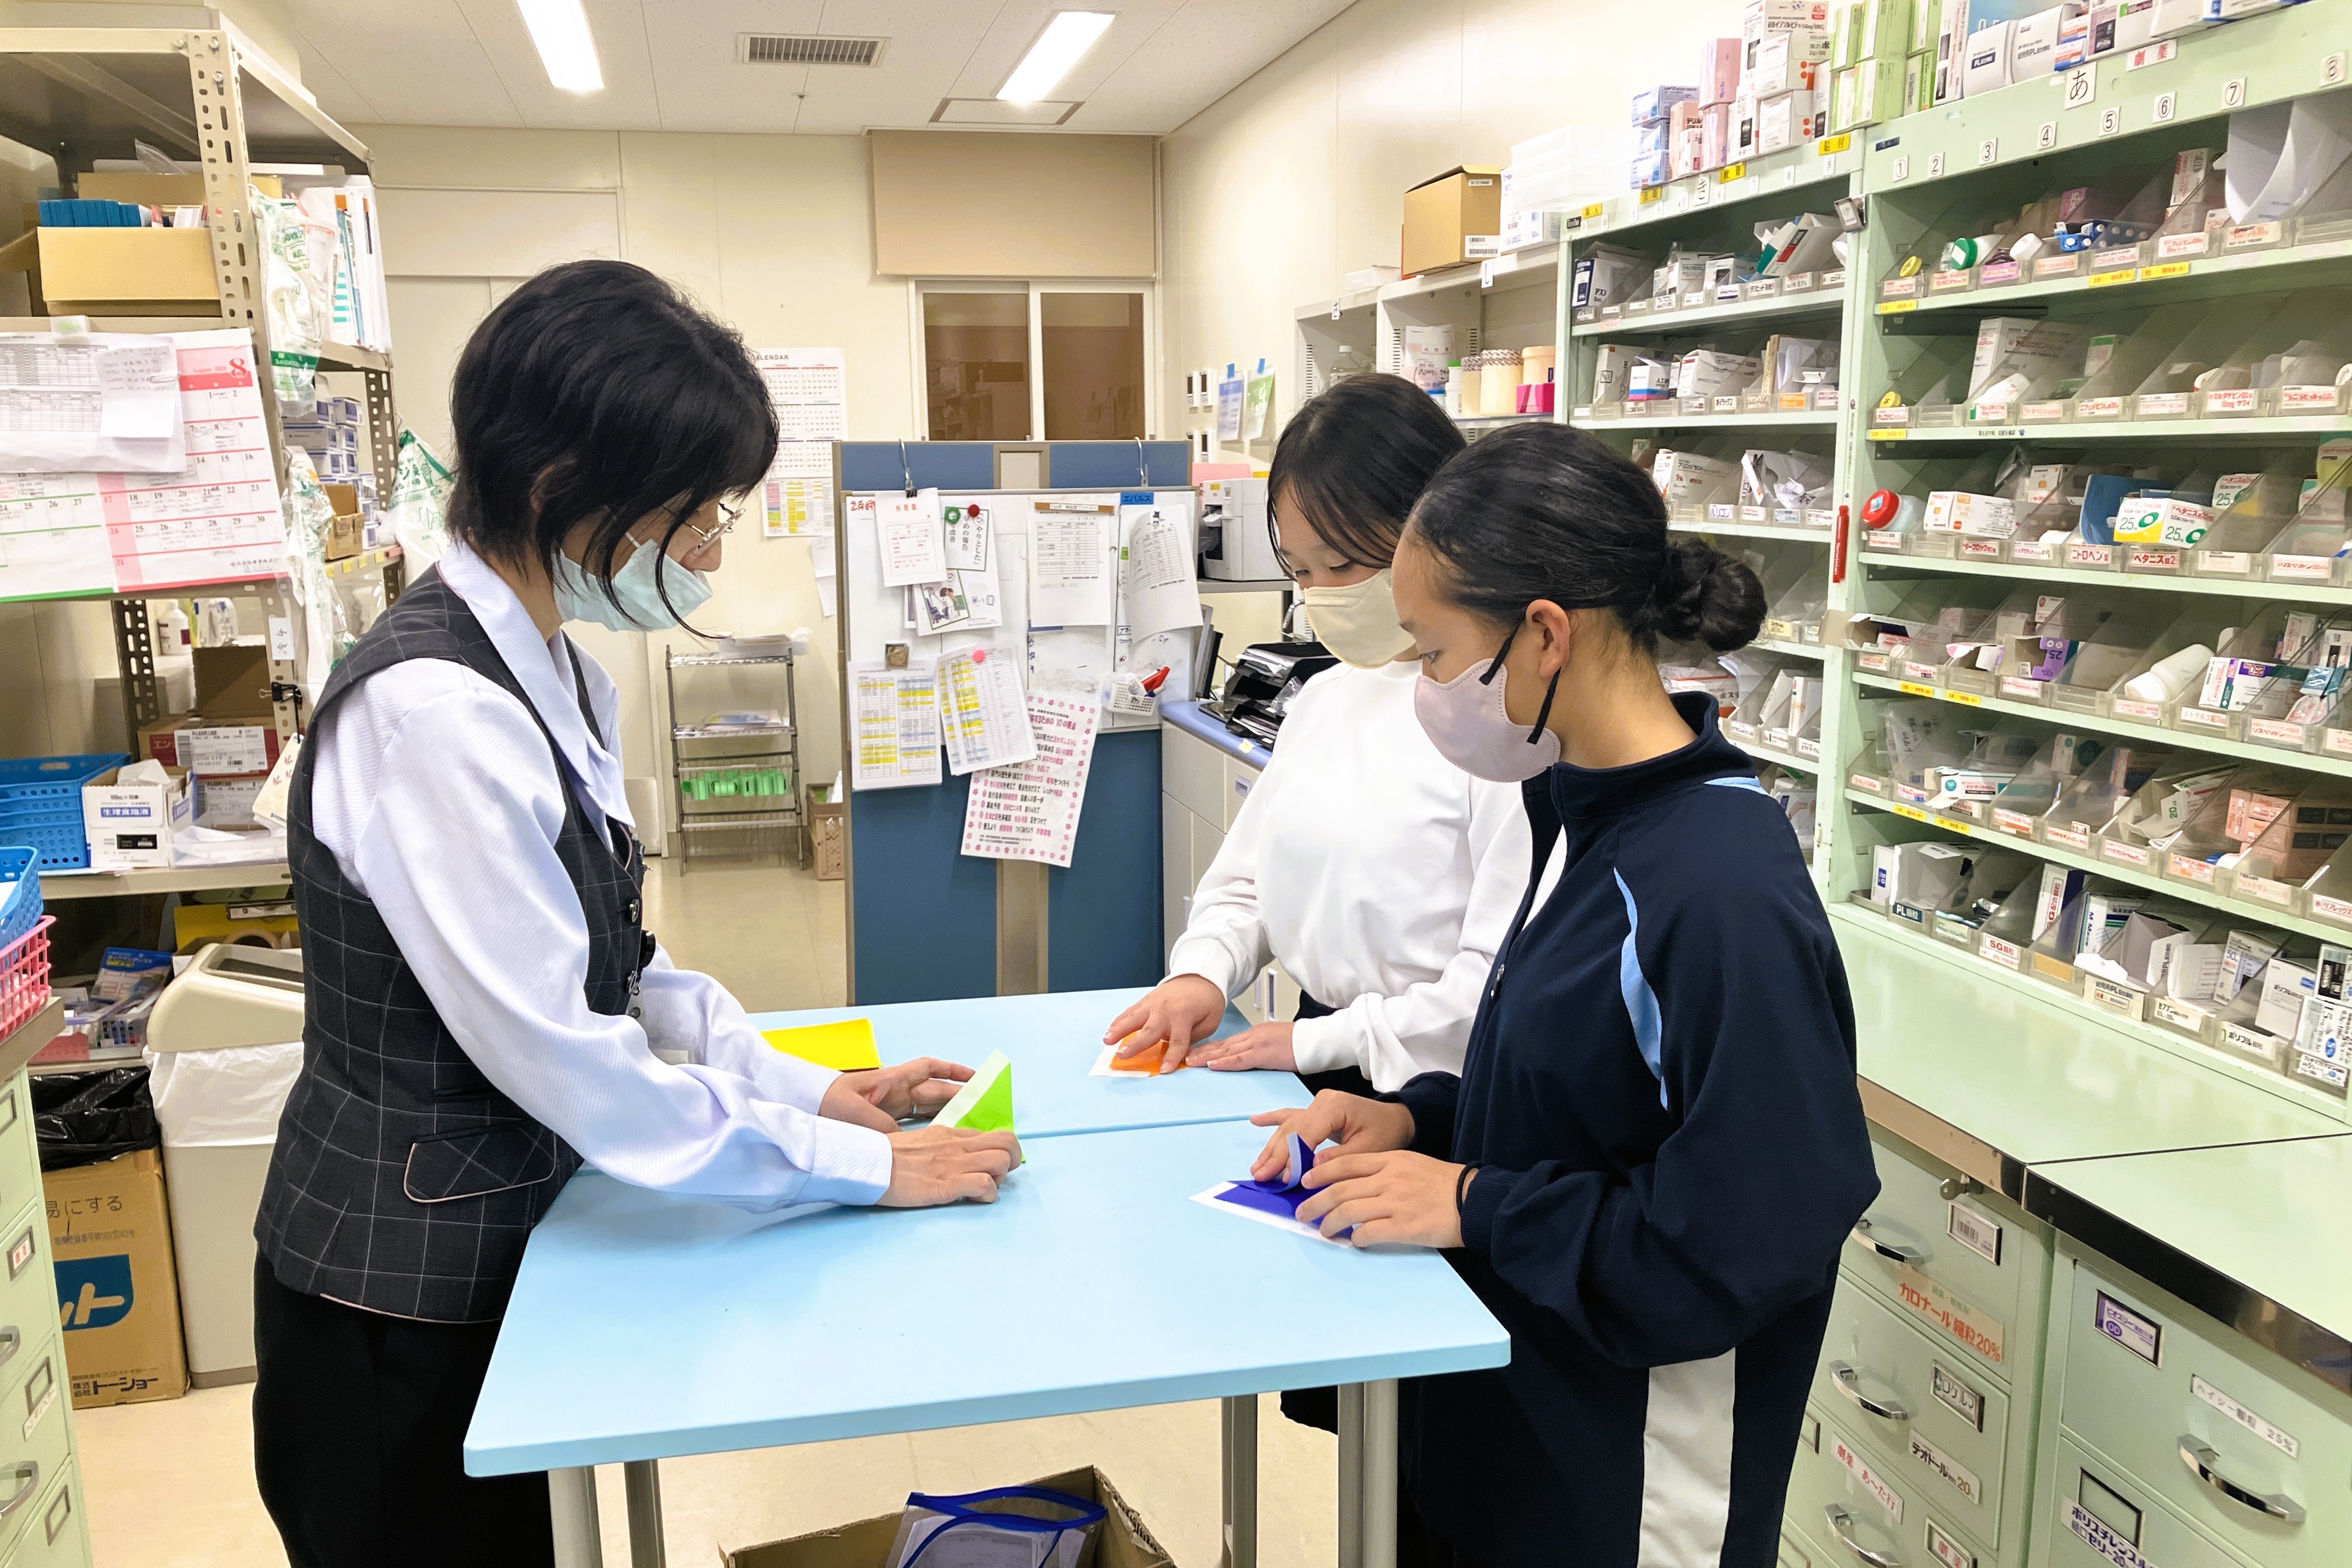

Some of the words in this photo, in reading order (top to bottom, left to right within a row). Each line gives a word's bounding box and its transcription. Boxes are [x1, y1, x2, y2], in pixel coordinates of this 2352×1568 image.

[2070, 70, 2088, 100] あ
[230, 358, 247, 377] 8
[1899, 1282, 2001, 1363] カロナール細粒20%
[93, 1377, 158, 1395] トーショー
